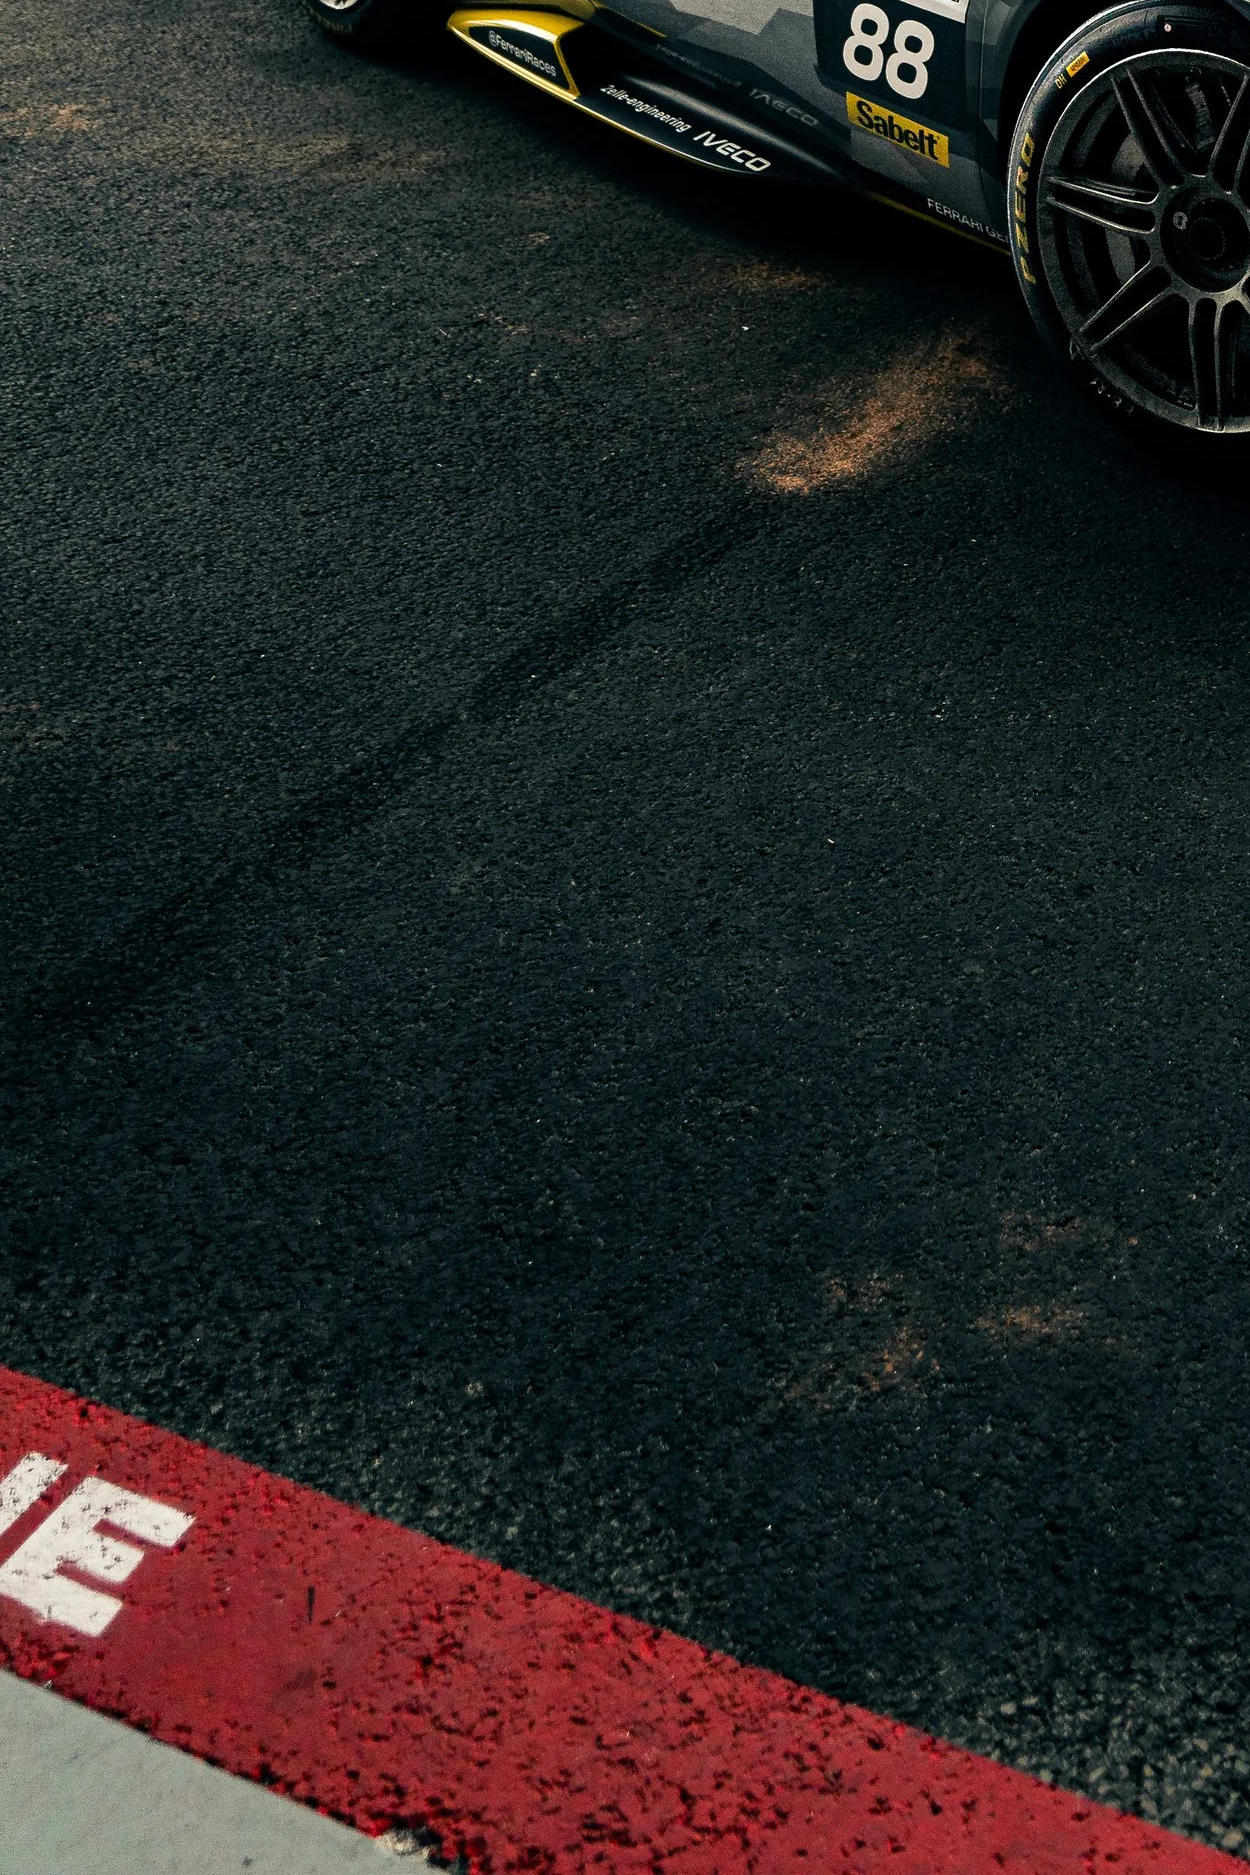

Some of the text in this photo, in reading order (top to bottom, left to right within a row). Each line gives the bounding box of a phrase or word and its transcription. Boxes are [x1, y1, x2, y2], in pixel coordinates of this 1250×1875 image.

[488, 30, 557, 77] @FerrariRaces
[843, 3, 935, 99] 88
[693, 130, 771, 172] IVECO
[856, 100, 939, 161] Sabelt
[927, 197, 984, 233] FERRARI
[0, 1452, 197, 1638] E
